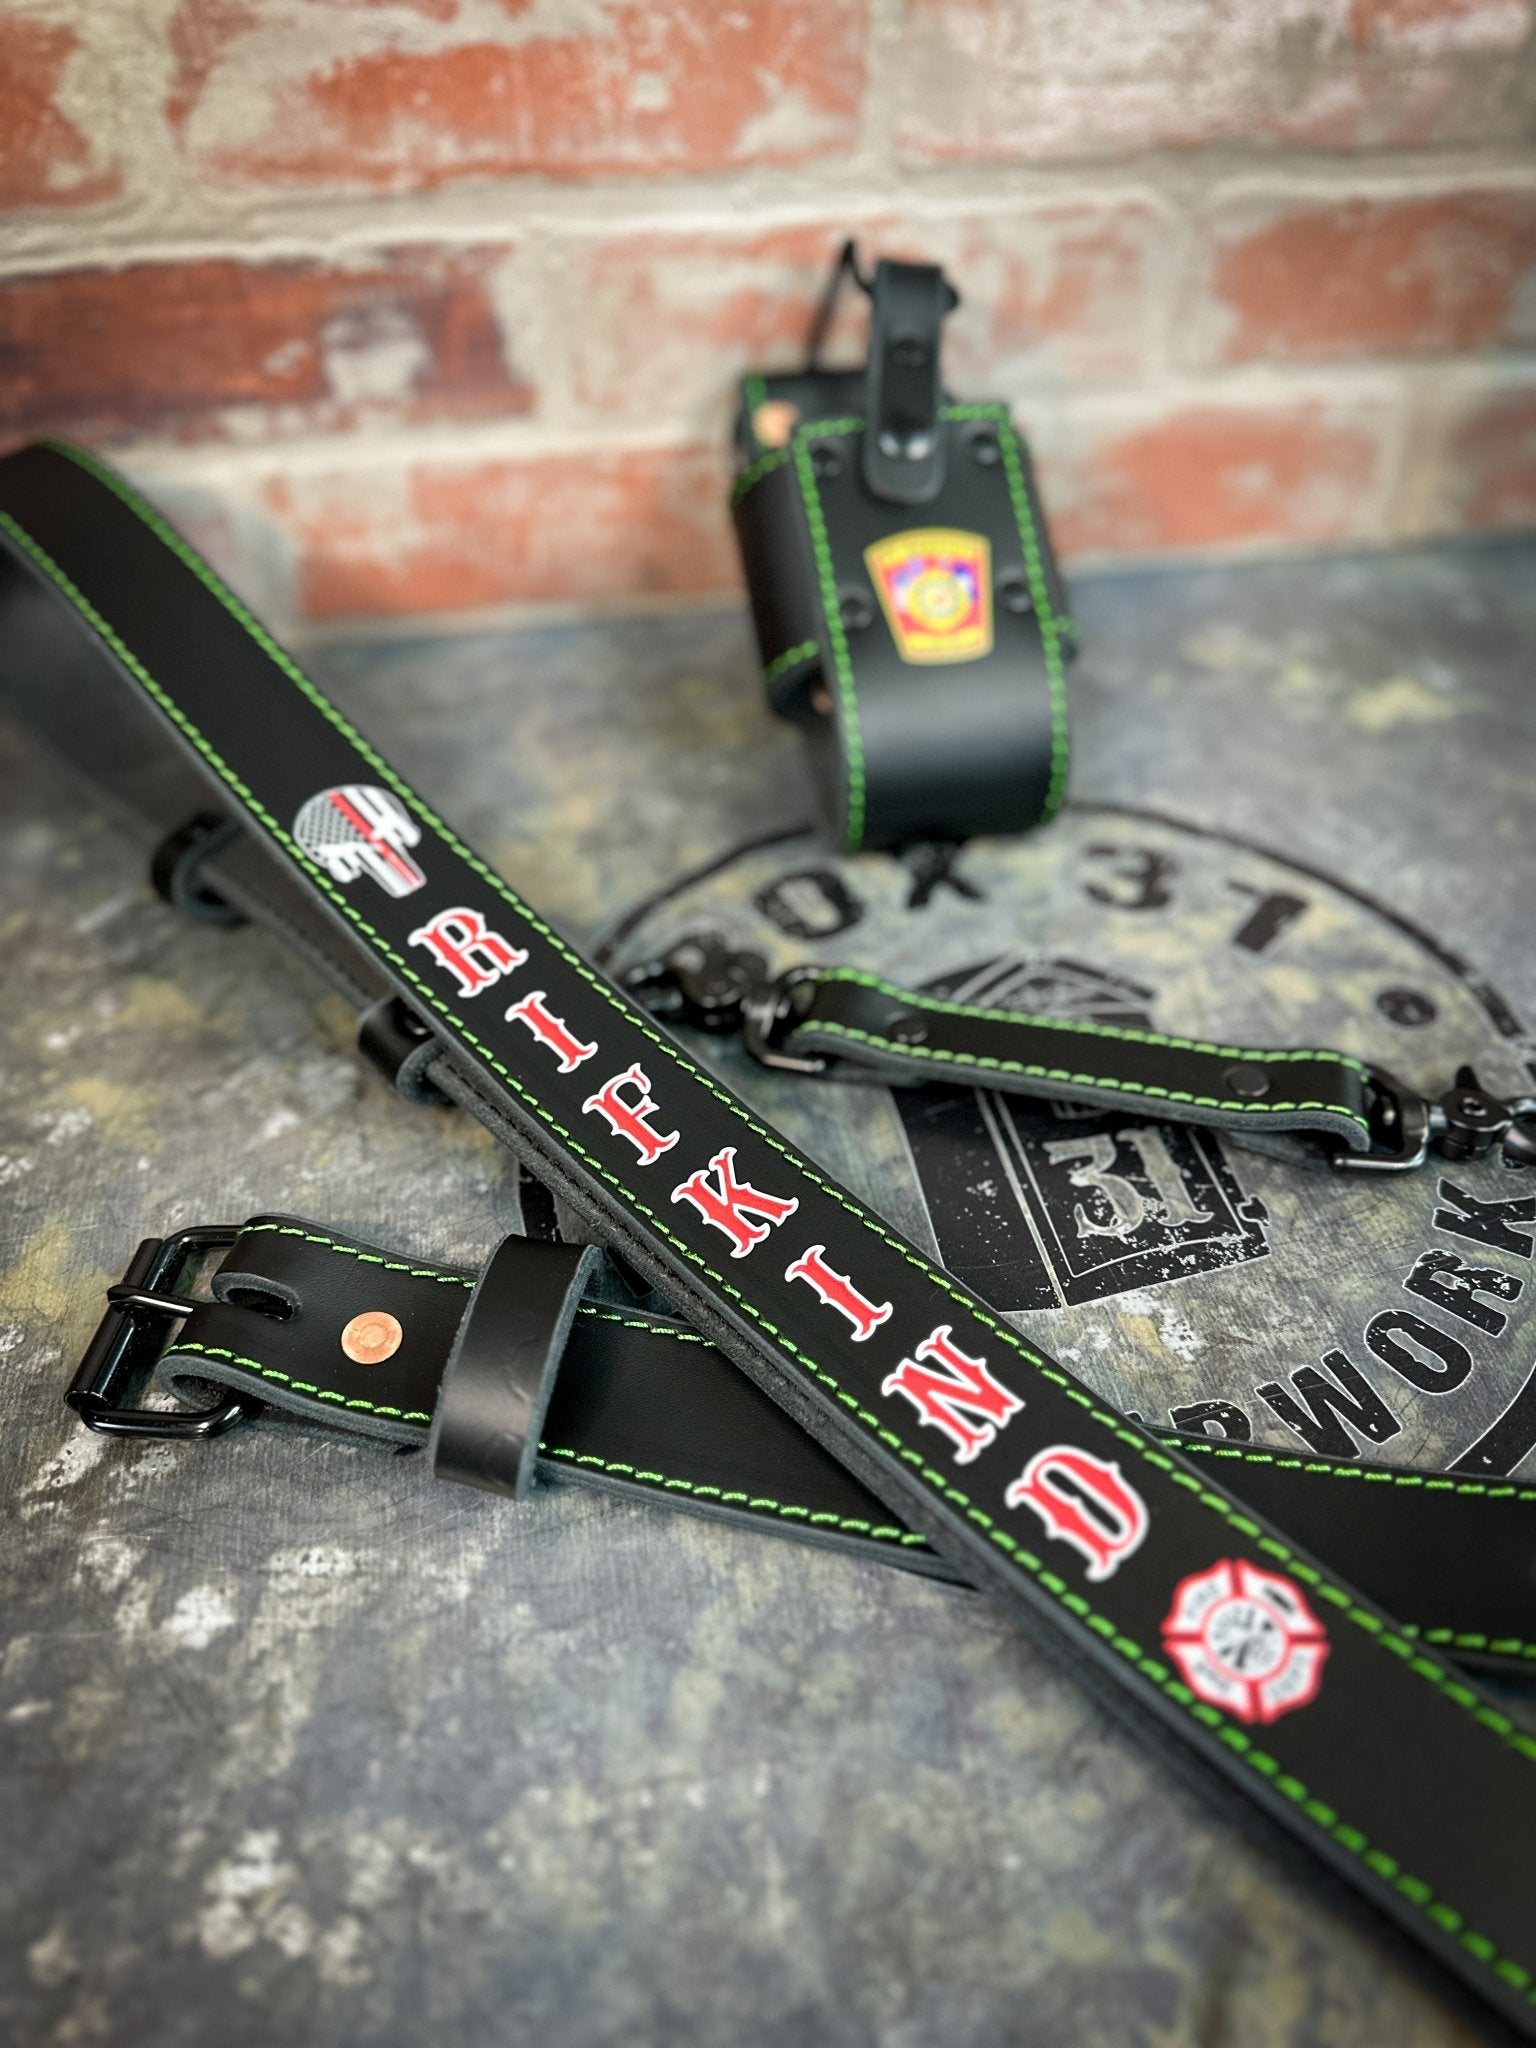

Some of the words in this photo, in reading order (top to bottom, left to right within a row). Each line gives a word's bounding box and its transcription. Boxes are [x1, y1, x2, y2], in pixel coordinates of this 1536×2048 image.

[408, 906, 1149, 1581] RIFKIND
[1042, 1126, 1215, 1238] 31
[1169, 1157, 1536, 1459] WORK
